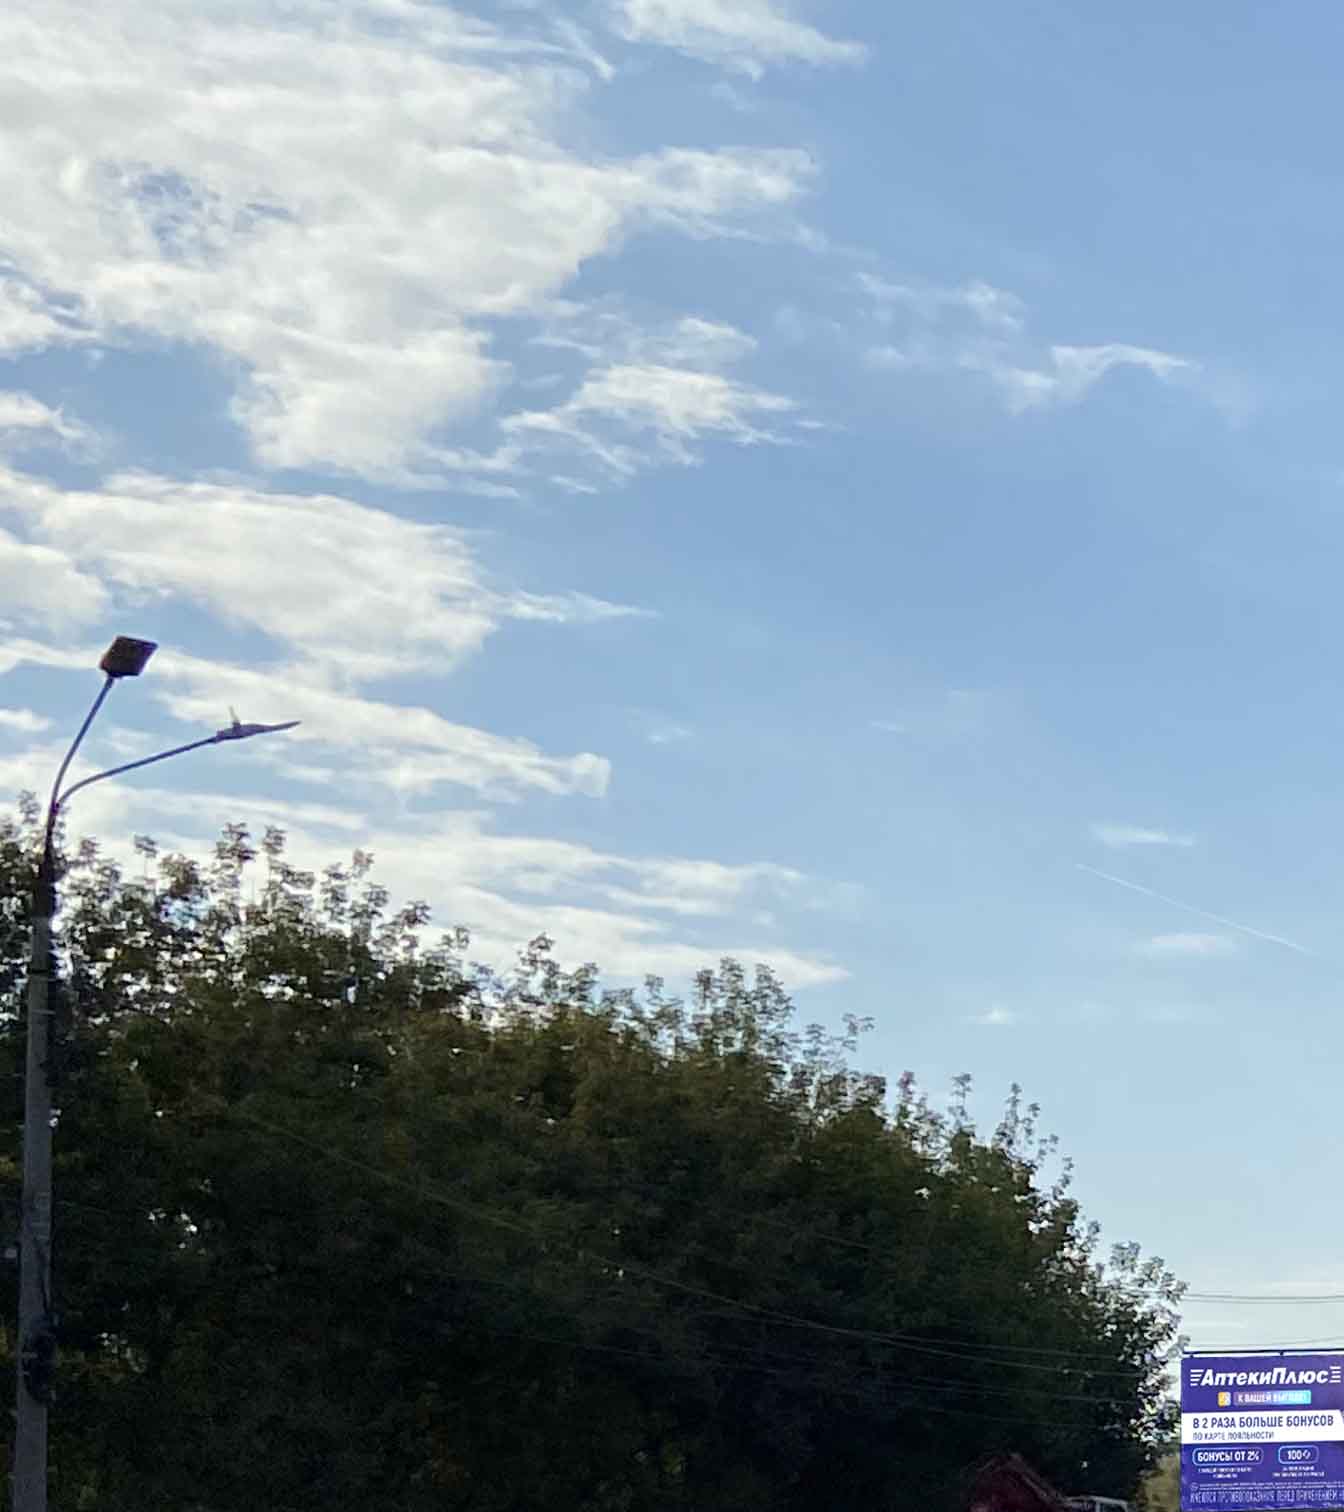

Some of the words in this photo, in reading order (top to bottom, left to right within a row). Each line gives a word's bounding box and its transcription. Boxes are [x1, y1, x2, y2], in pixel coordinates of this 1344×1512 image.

[1200, 1367, 1329, 1386] АптекиПлюс
[1202, 1417, 1209, 1428] 2
[1211, 1416, 1236, 1428] РАЗА
[1239, 1415, 1284, 1428] БОЛЬШЕ
[1286, 1415, 1334, 1427] БОНУСОВ
[1197, 1451, 1233, 1462] БОНУСЫ
[1234, 1451, 1246, 1461] ОТ
[1247, 1450, 1260, 1461] 2%
